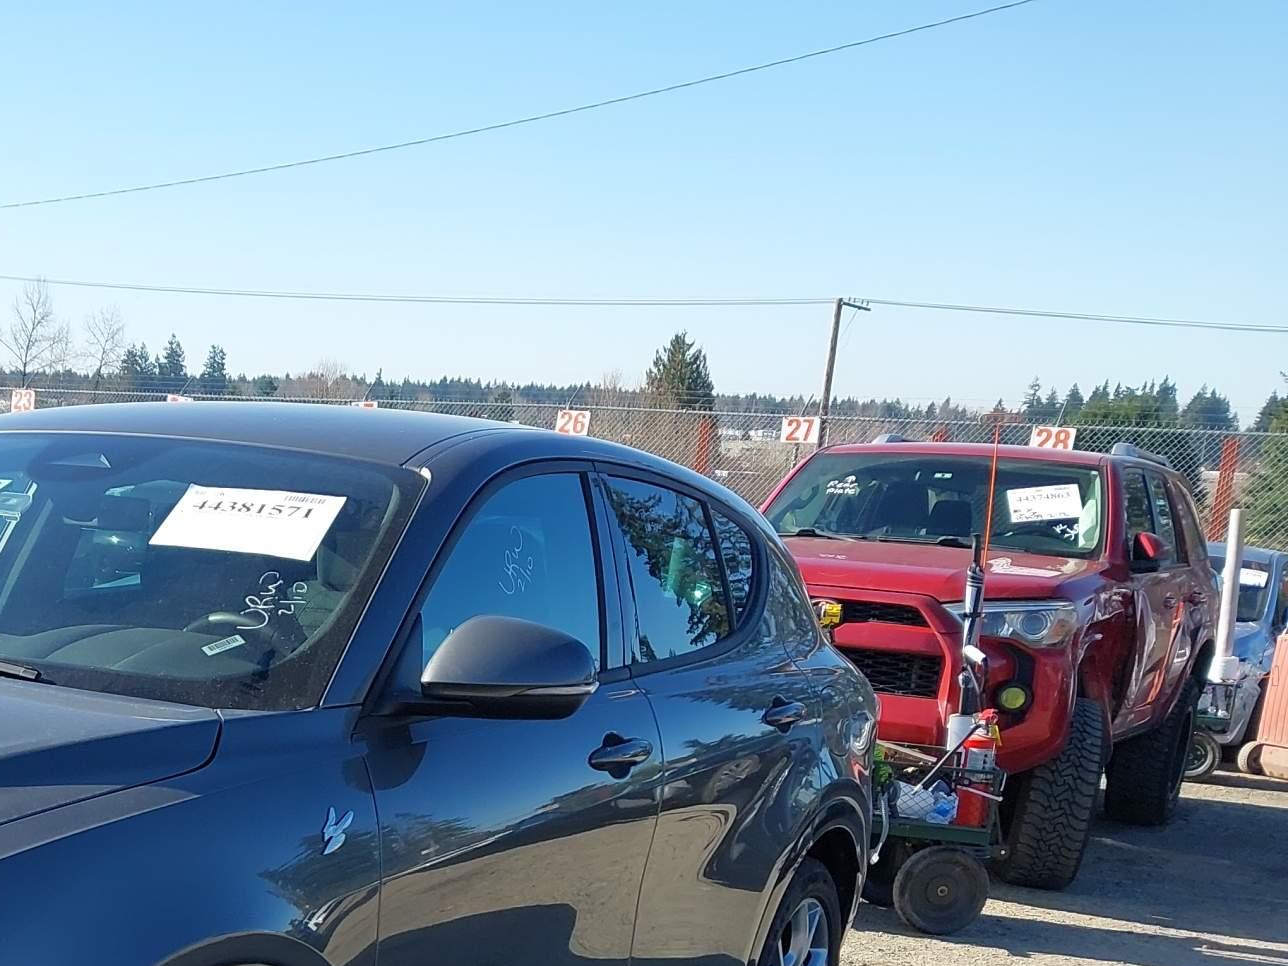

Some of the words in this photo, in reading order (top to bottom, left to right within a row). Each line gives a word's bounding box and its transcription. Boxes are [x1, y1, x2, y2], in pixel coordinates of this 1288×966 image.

[13, 391, 34, 410] 23
[558, 412, 586, 434] 26
[786, 419, 813, 441] 27
[1035, 428, 1071, 450] 28
[192, 499, 315, 519] 44381571
